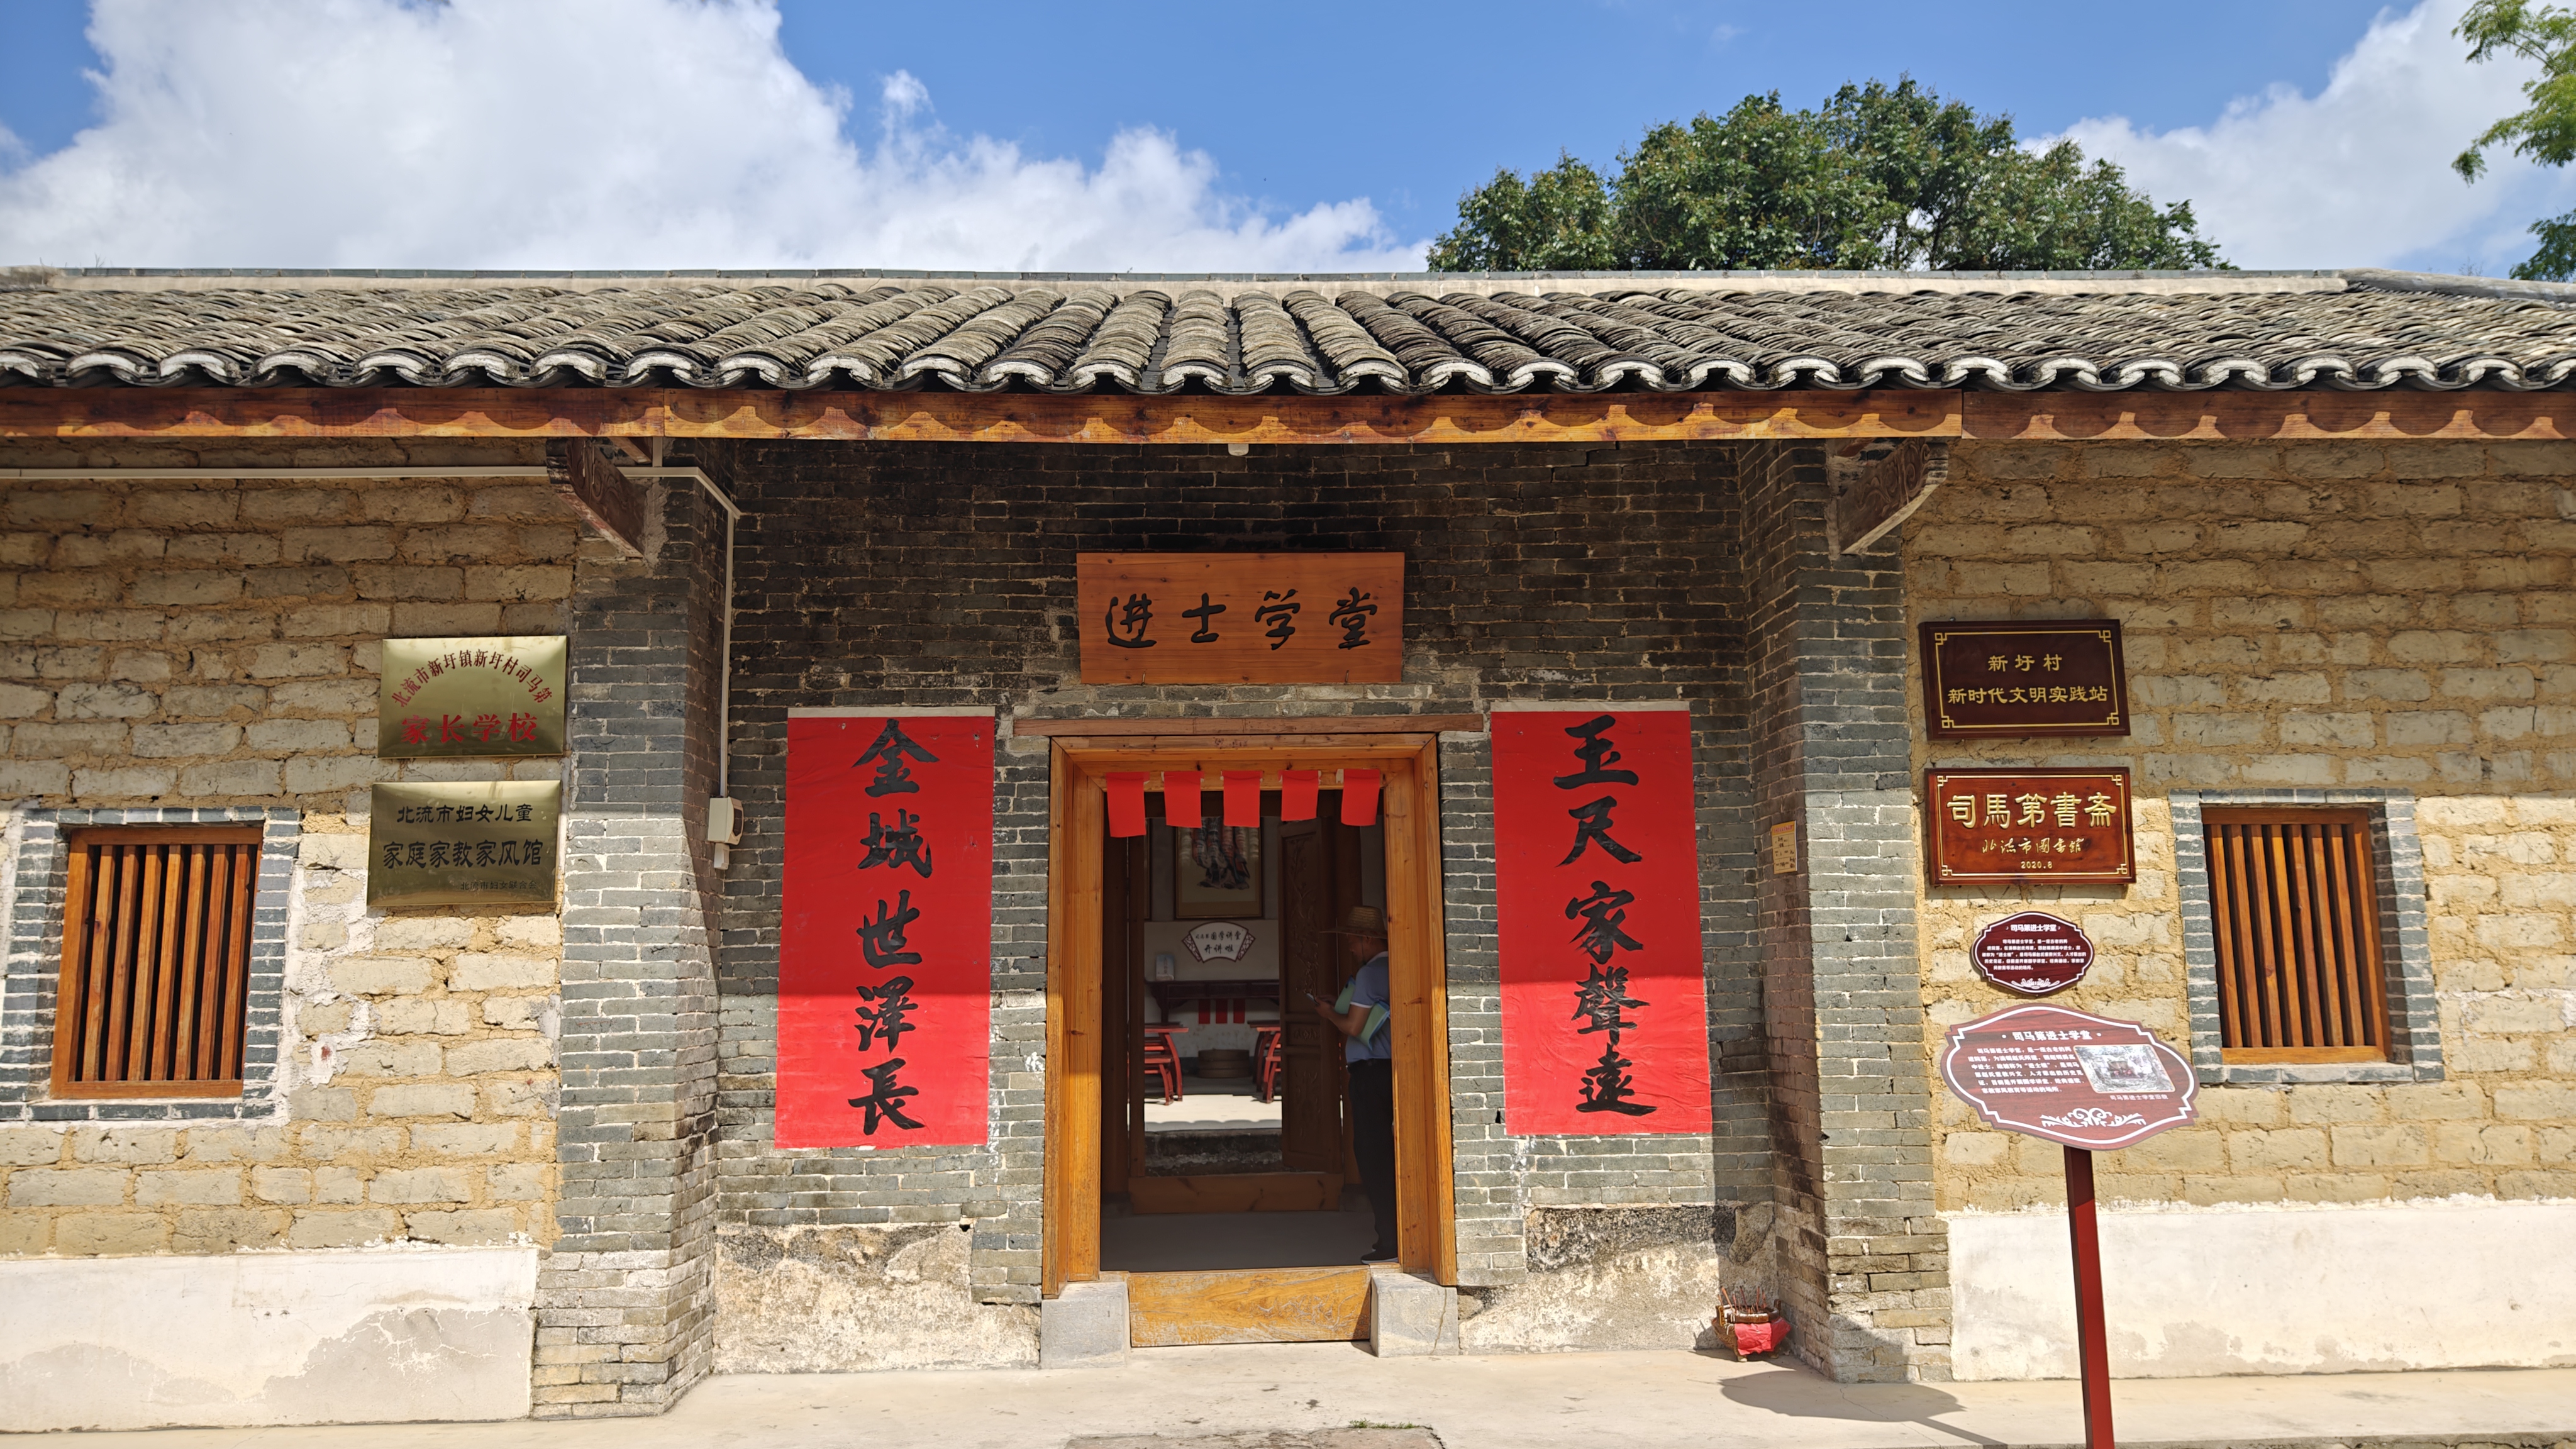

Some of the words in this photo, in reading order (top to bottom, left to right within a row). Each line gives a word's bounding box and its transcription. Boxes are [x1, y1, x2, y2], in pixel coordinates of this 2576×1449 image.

[1105, 586, 1378, 651] 进士学堂
[1988, 653, 2062, 672] 新圩村
[391, 648, 552, 707] 北流市新圩镇新圩村司马第
[1948, 686, 2108, 704] 新时代文明实践站
[401, 713, 538, 744] 家长学校
[397, 803, 533, 824] 北流市妇女儿童
[383, 838, 543, 869] 家庭家教家风馆
[2021, 861, 2053, 869] 2020.8
[460, 880, 537, 890] 北流市妇女联合会
[2010, 924, 2057, 932] 司马第进士学堂
[2012, 1030, 2092, 1041] 司马第进士学堂
